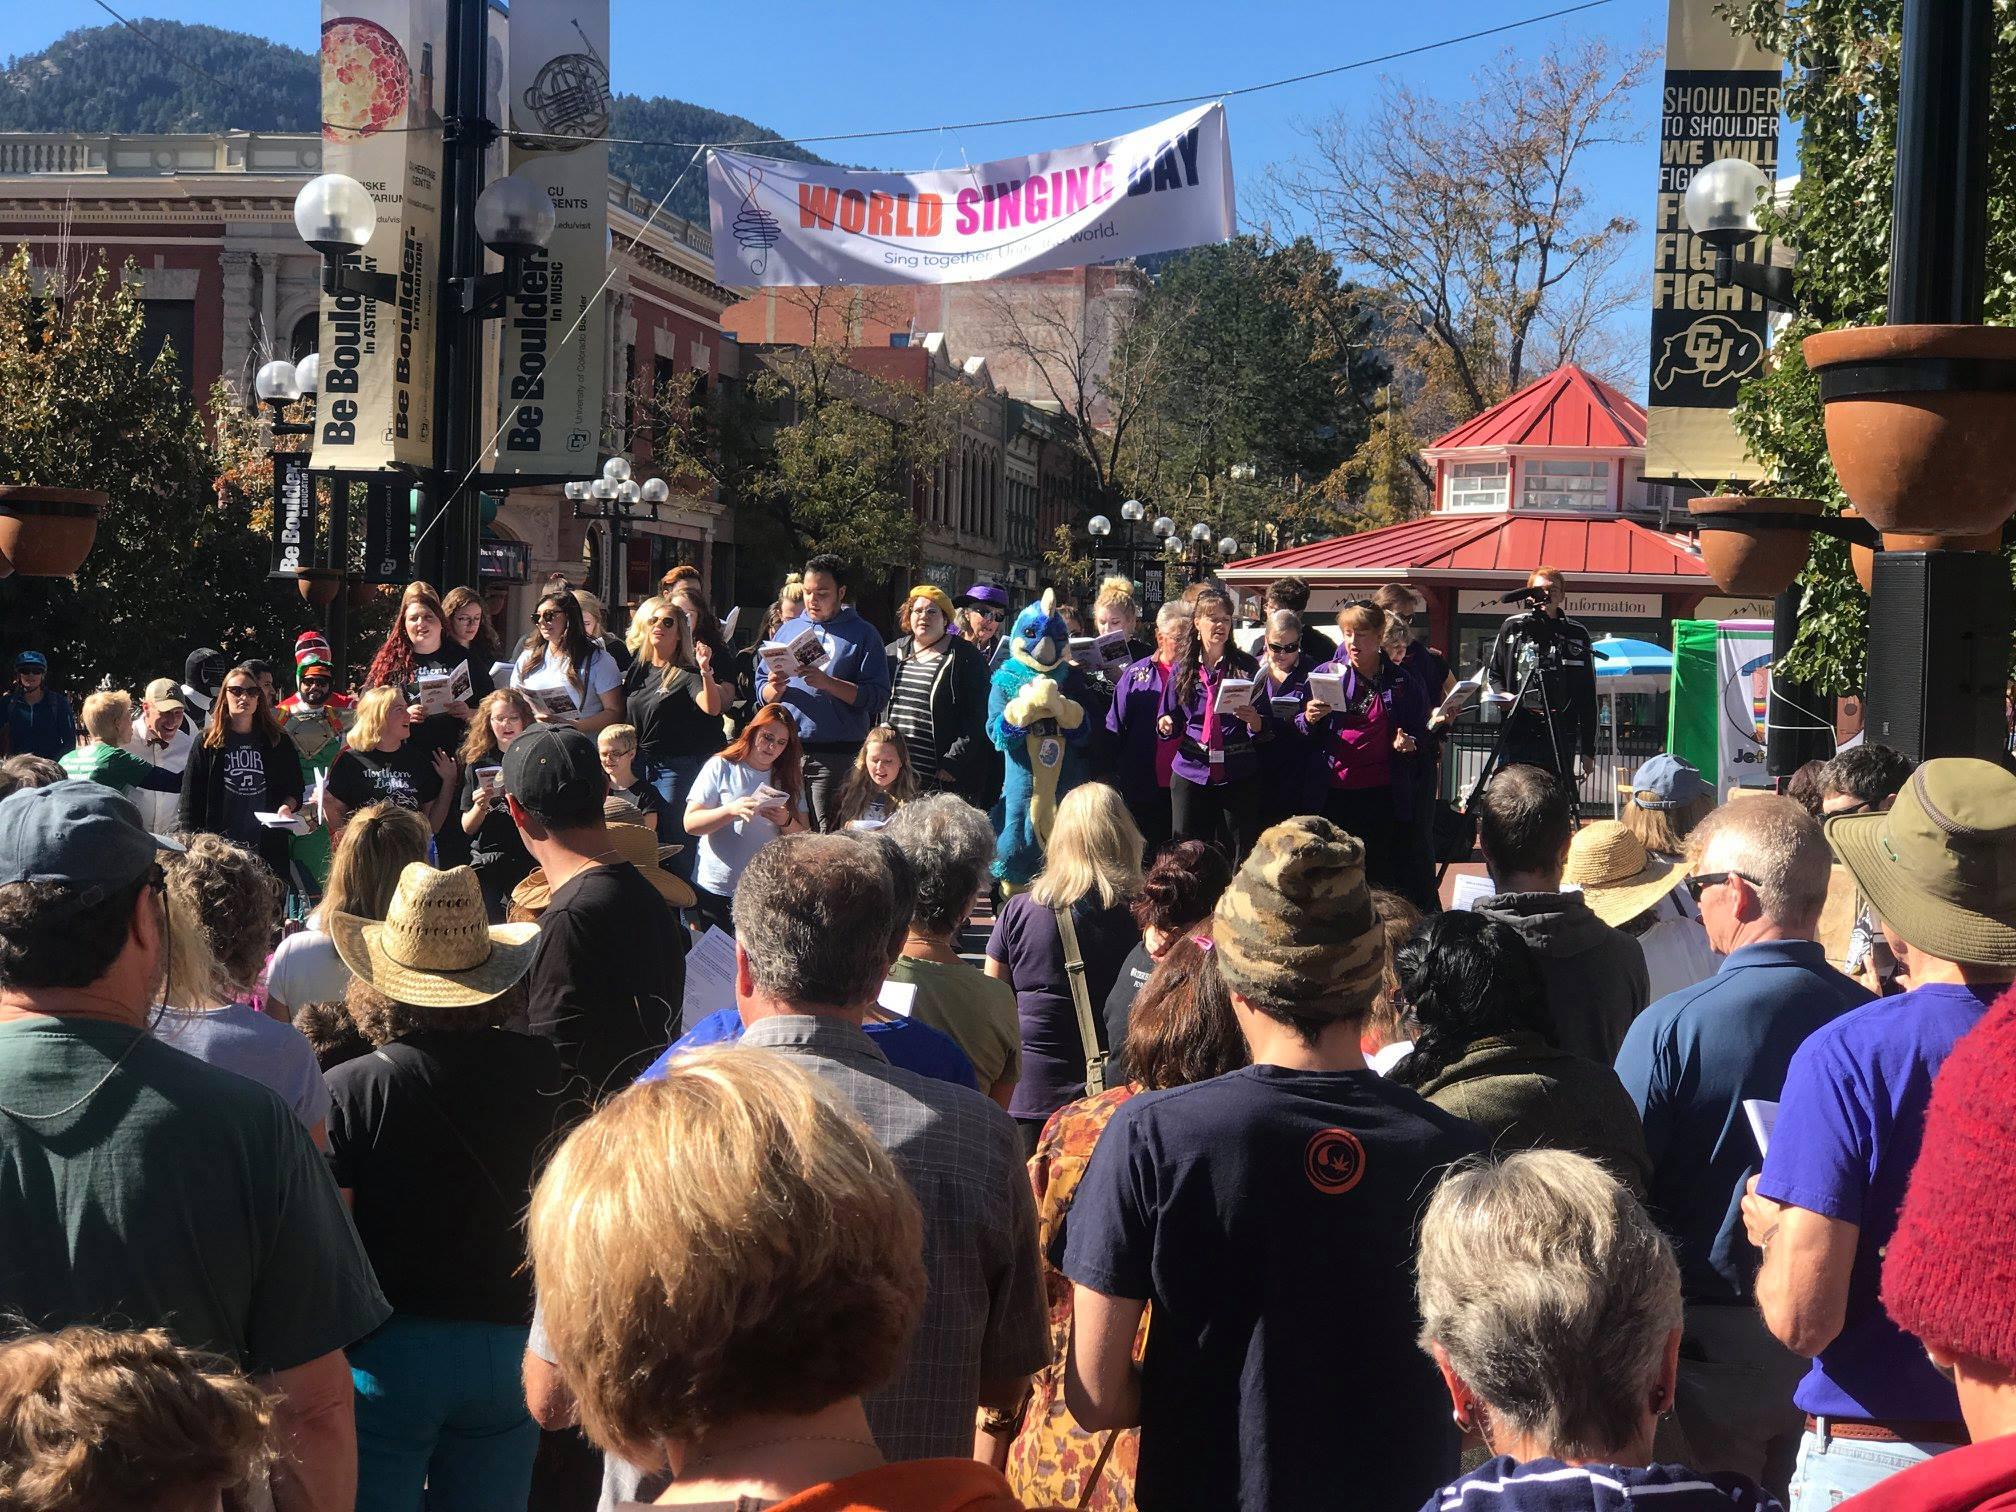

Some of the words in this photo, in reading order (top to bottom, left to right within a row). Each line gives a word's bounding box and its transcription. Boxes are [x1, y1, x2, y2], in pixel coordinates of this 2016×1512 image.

[1663, 86, 1781, 115] SHOULDER
[1662, 116, 1683, 137] TO
[1690, 116, 1780, 137] SHOULDER
[1661, 139, 1705, 165] WE
[1713, 140, 1777, 166] WILL
[360, 181, 387, 191] ISKE
[547, 186, 564, 197] CU
[798, 183, 943, 238] WORLD
[956, 161, 1115, 236] SINGING
[1127, 127, 1201, 198] DAY
[551, 198, 588, 209] SENTS
[884, 252, 919, 269] Sing
[1070, 222, 1119, 243] world.
[412, 242, 424, 315] TRADITION
[551, 261, 564, 305] MUSIC
[413, 320, 420, 331] In
[550, 309, 562, 321] In
[364, 337, 375, 354] In
[576, 334, 587, 372] Colorado
[1685, 324, 1735, 371] CU
[576, 374, 584, 382] of
[396, 389, 410, 439] Be
[575, 385, 586, 424] University
[322, 398, 359, 445] Be
[507, 405, 544, 452] Be
[301, 473, 309, 508] EDUCATIO
[280, 546, 300, 571] Be
[1146, 581, 1162, 592] RAL
[1564, 597, 1646, 613] Information
[224, 750, 264, 772] CHOIR
[1733, 748, 1766, 764] Jef
[363, 767, 411, 778] Northern
[374, 778, 409, 793] Lights
